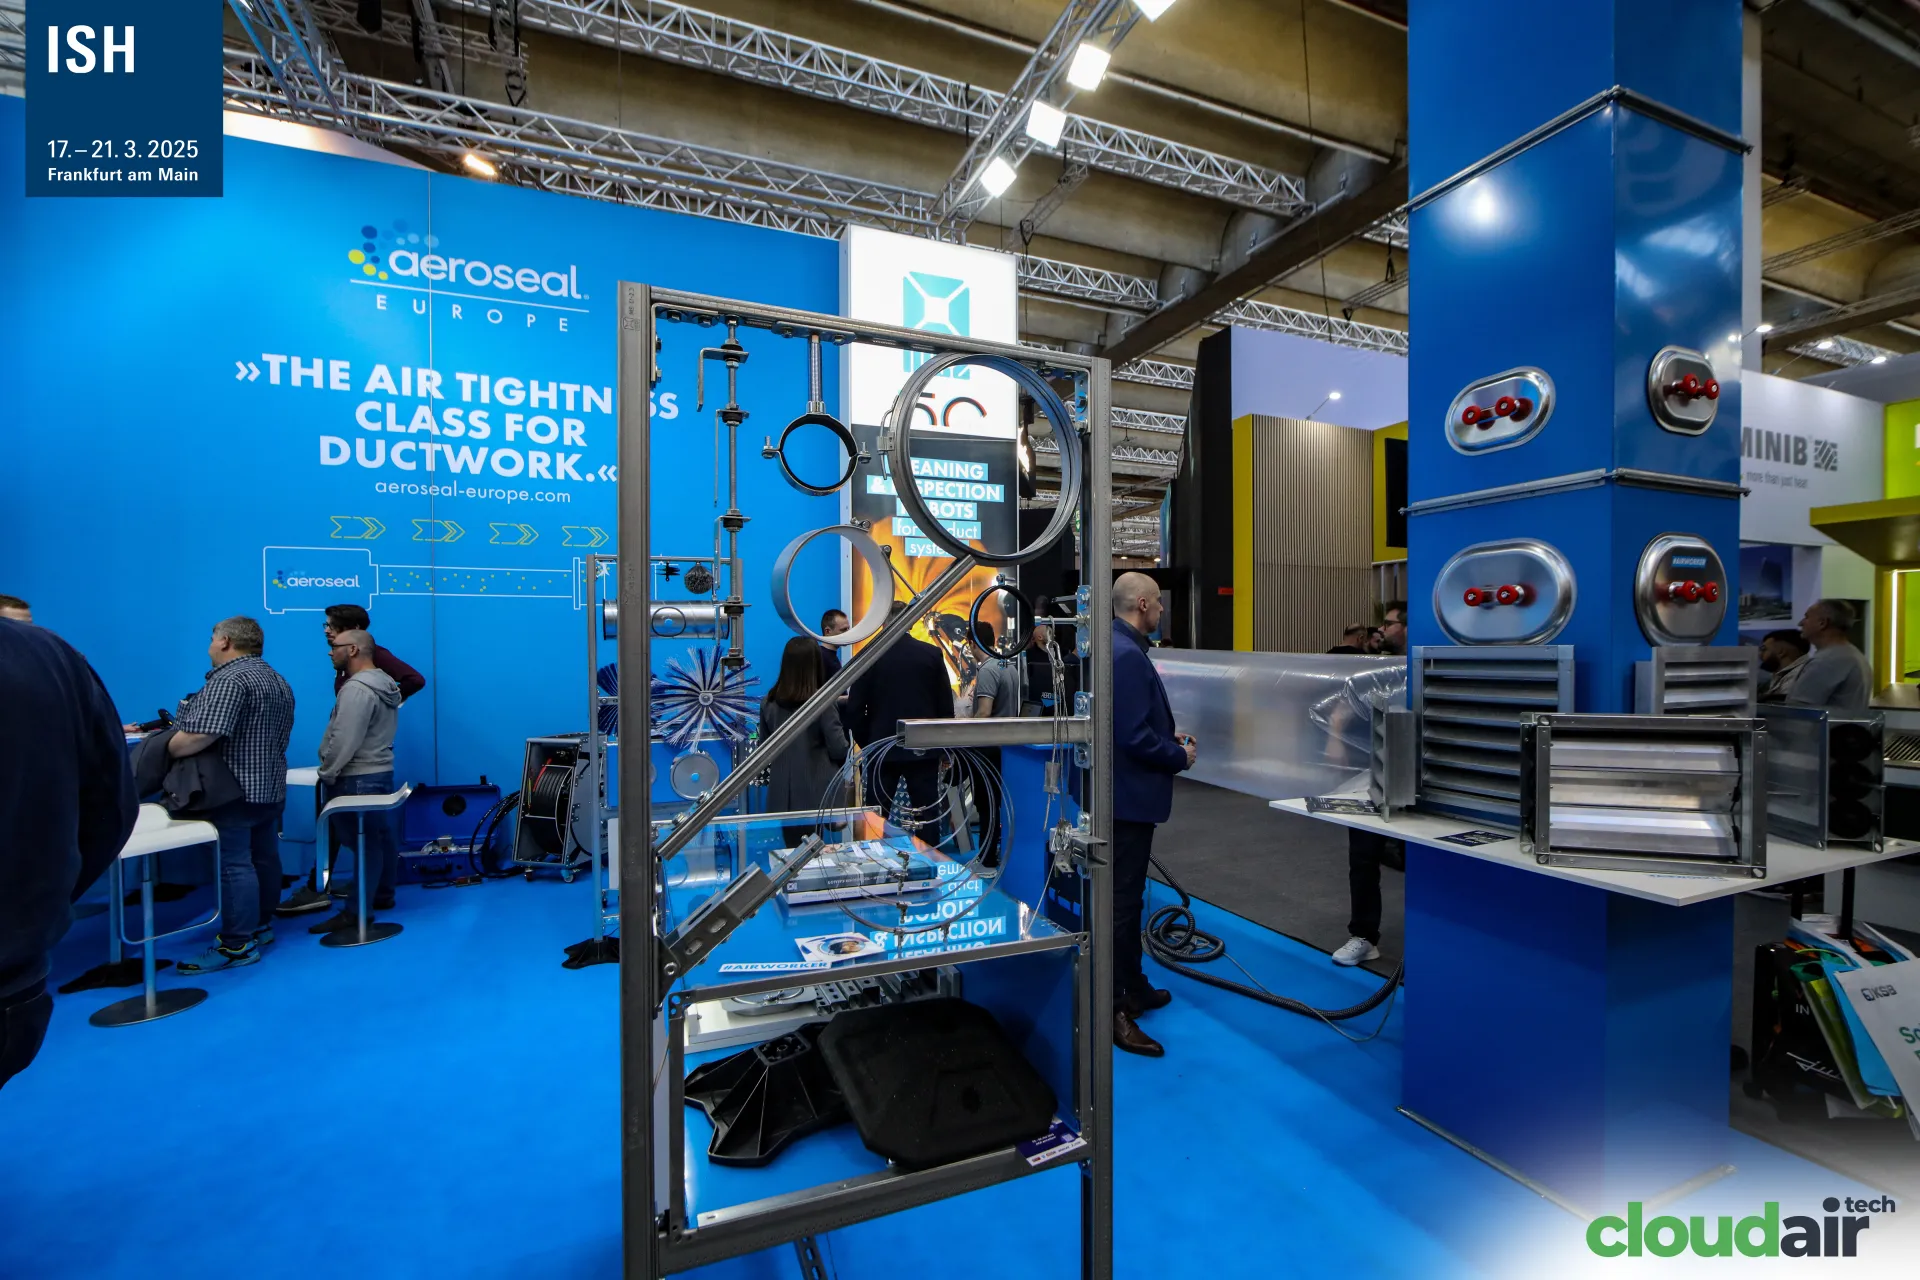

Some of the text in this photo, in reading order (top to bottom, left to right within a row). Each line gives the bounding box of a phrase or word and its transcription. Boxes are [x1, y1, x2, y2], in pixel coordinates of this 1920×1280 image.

[388, 249, 582, 300] aeroseal
[376, 294, 568, 332] EUROPE
[364, 364, 447, 399] AIR
[355, 401, 588, 447] CLASS FOR
[375, 479, 571, 504] aeroseal-europe.com
[286, 574, 361, 588] aeroseal
[723, 962, 828, 971] #AIRWORKER
[1873, 984, 1898, 999] KSB
